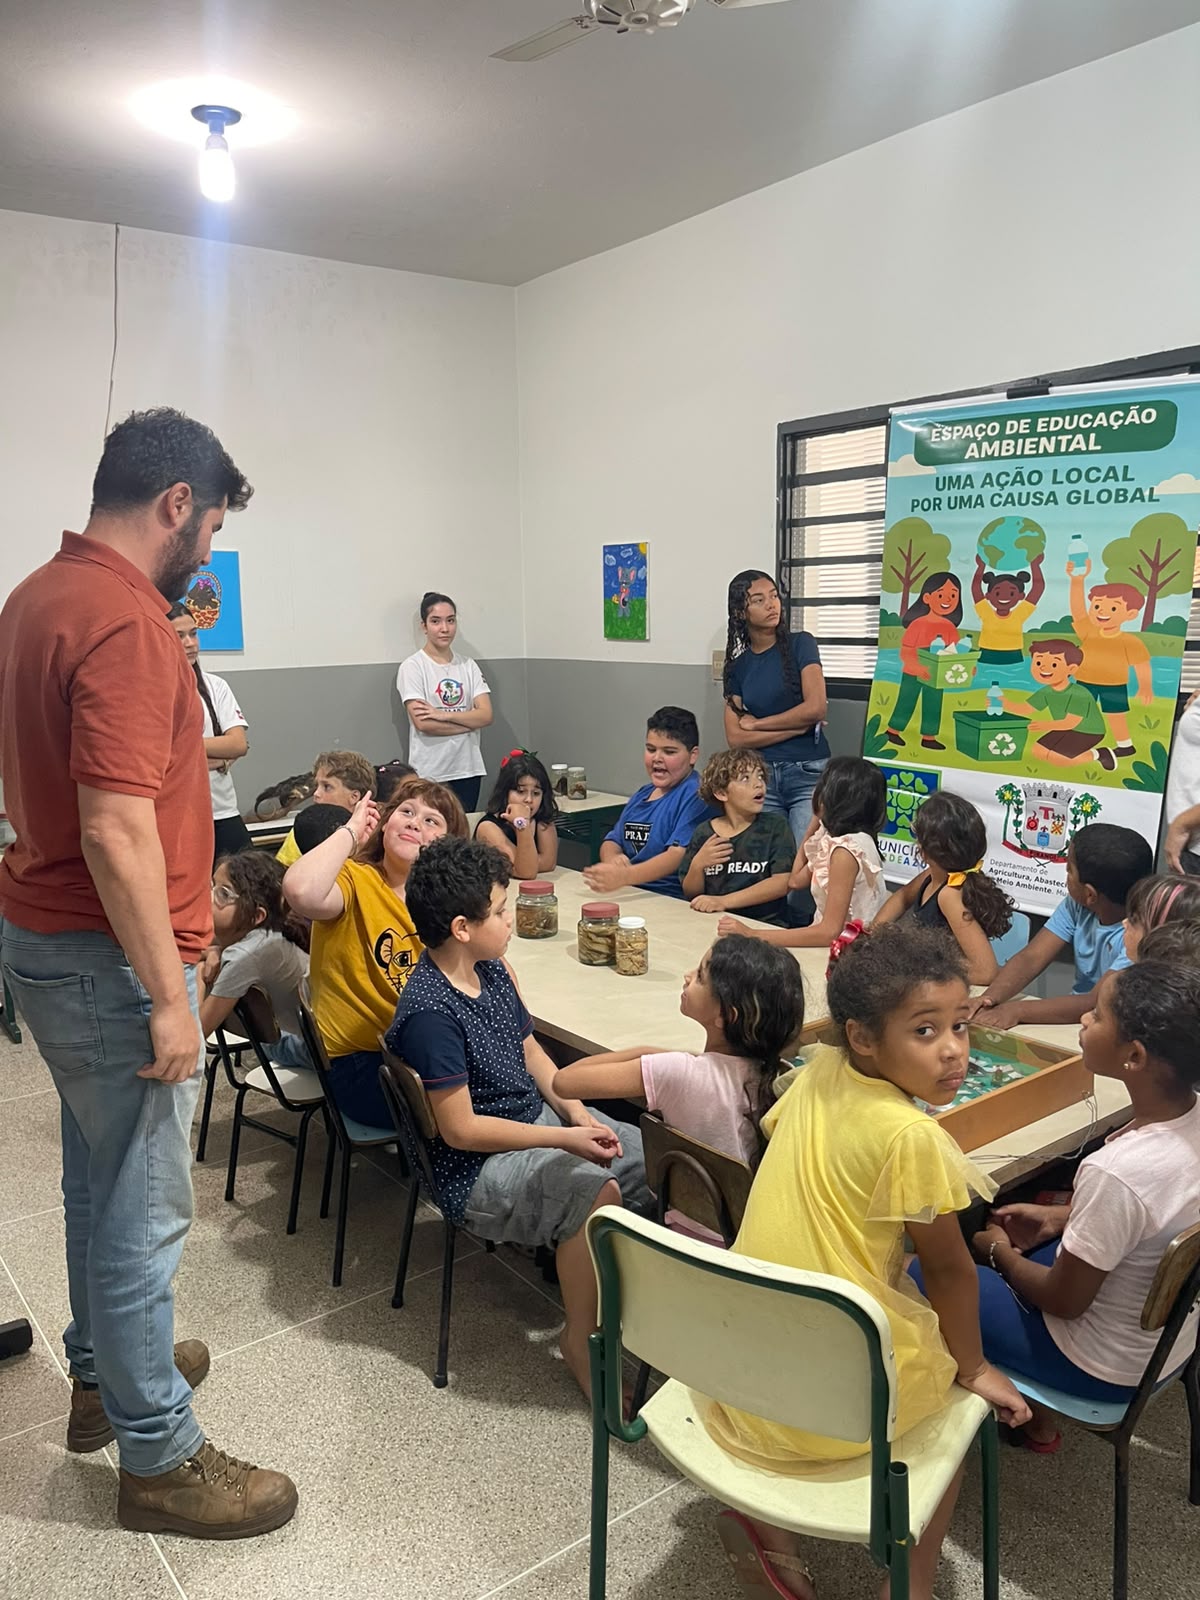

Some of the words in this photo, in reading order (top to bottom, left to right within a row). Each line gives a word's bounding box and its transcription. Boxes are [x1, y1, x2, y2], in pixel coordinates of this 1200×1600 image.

[931, 421, 1000, 442] ESPAÇO
[1005, 419, 1031, 435] DE
[1037, 406, 1157, 432] EDUCAÇÃO
[964, 432, 1102, 460] AMBIENTAL
[935, 473, 975, 492] UMA
[980, 466, 1043, 491] AÇÃO
[1051, 464, 1136, 485] LOCAL
[910, 497, 942, 513] POR
[947, 493, 985, 511] UMA
[990, 490, 1059, 508] CAUSA
[1066, 486, 1160, 506] GLOBAL
[728, 861, 768, 874] READY
[988, 867, 1032, 882] Agricultura,
[990, 858, 1038, 873] Departamento
[1039, 868, 1049, 876] de
[996, 877, 1014, 886] Meio
